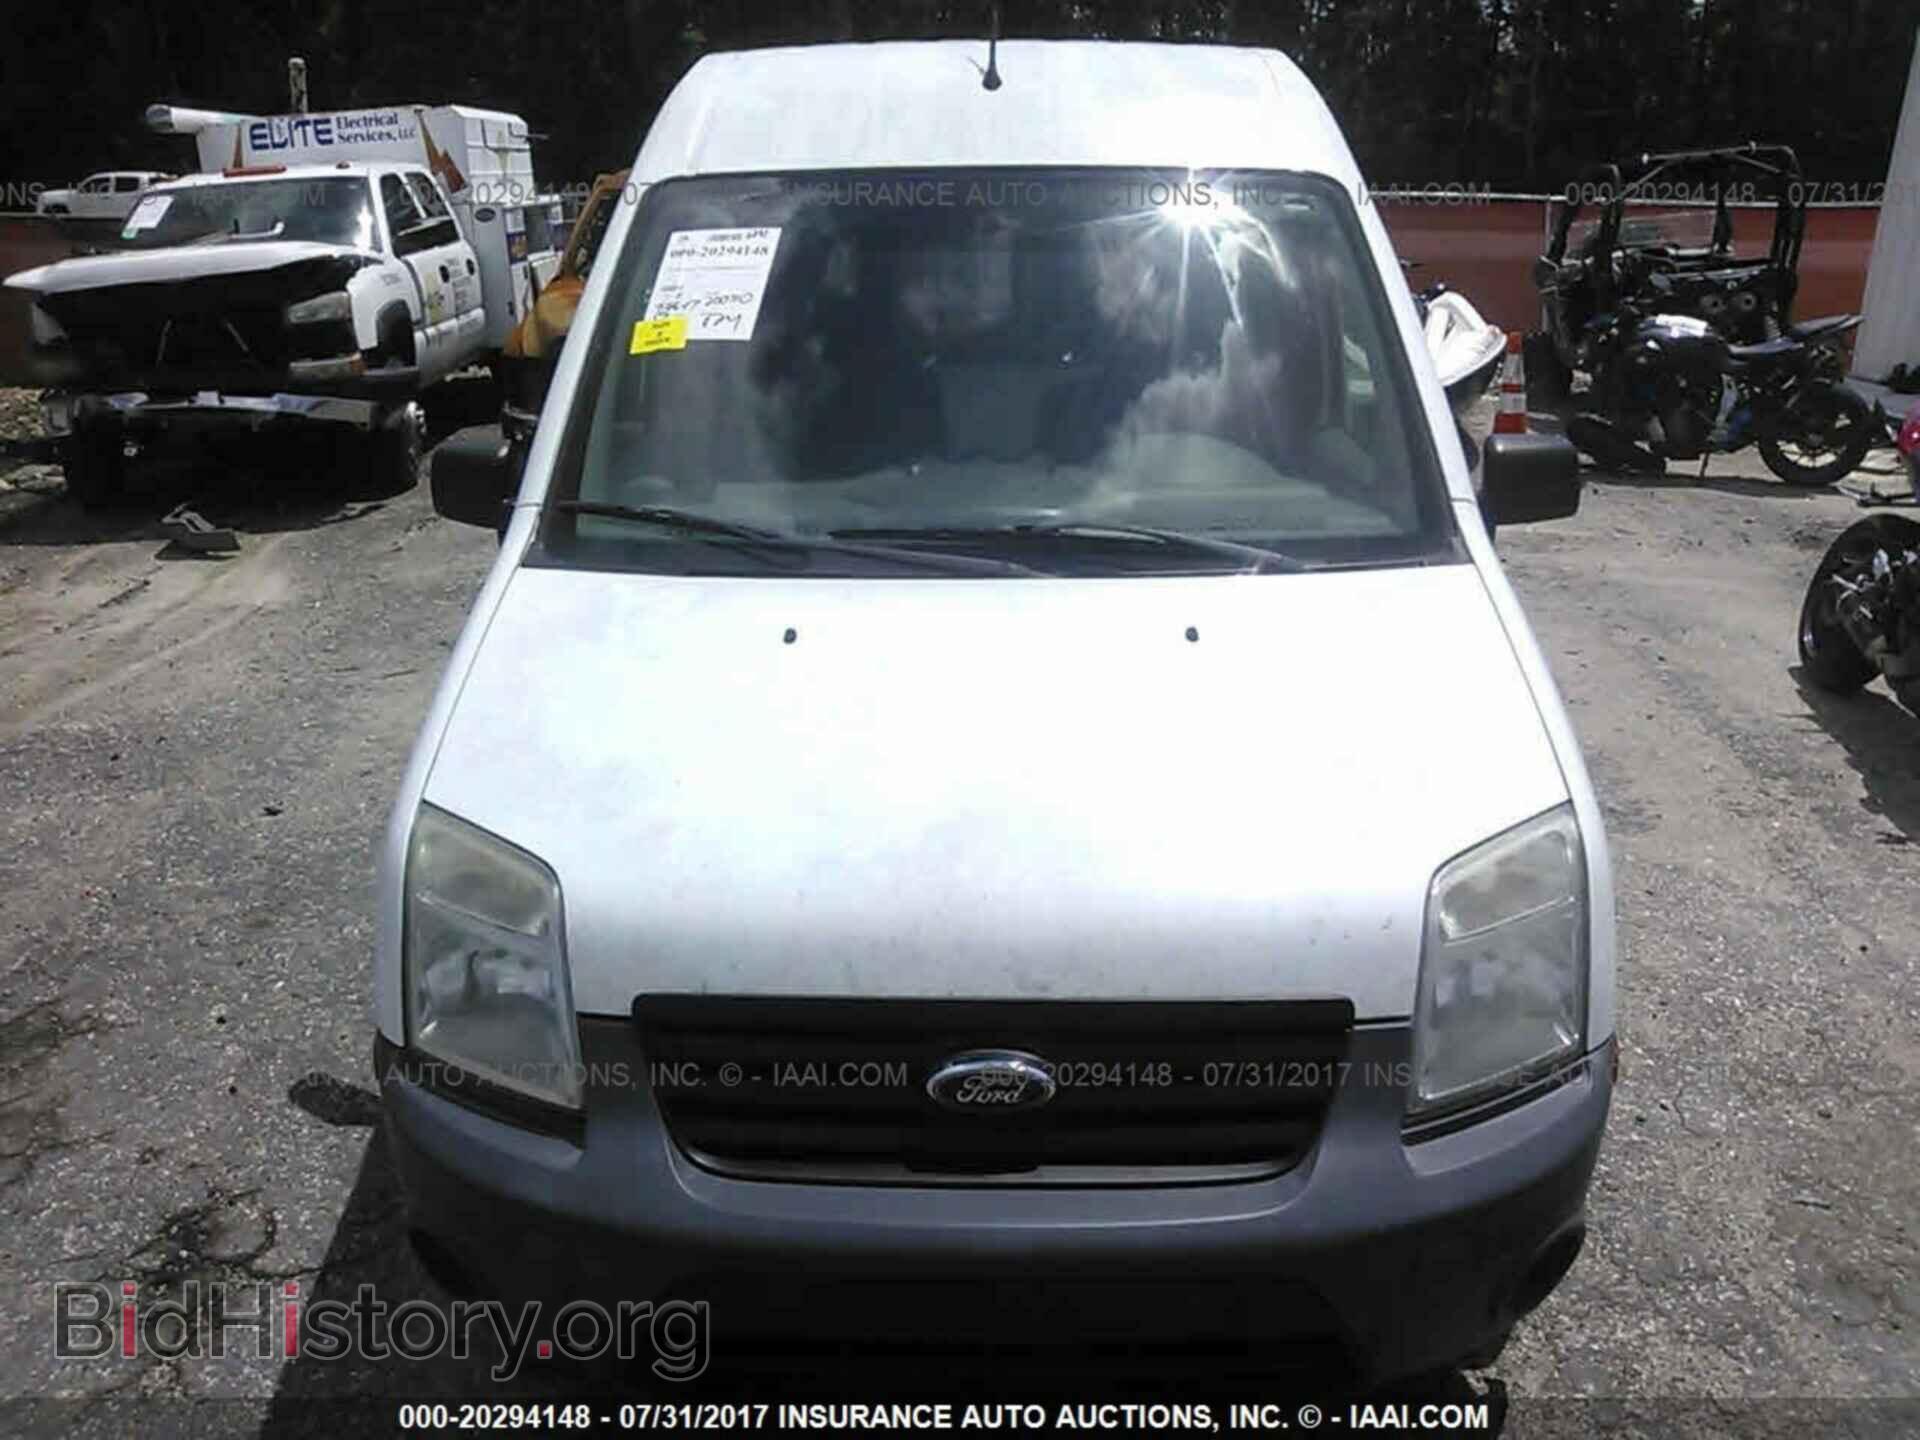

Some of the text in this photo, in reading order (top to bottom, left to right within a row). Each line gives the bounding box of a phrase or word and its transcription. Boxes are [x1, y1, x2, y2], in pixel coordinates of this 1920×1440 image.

[336, 112, 399, 130] Electrical
[249, 117, 334, 151] ELITE
[337, 128, 398, 144] Services,
[956, 1072, 1029, 1104] Ford
